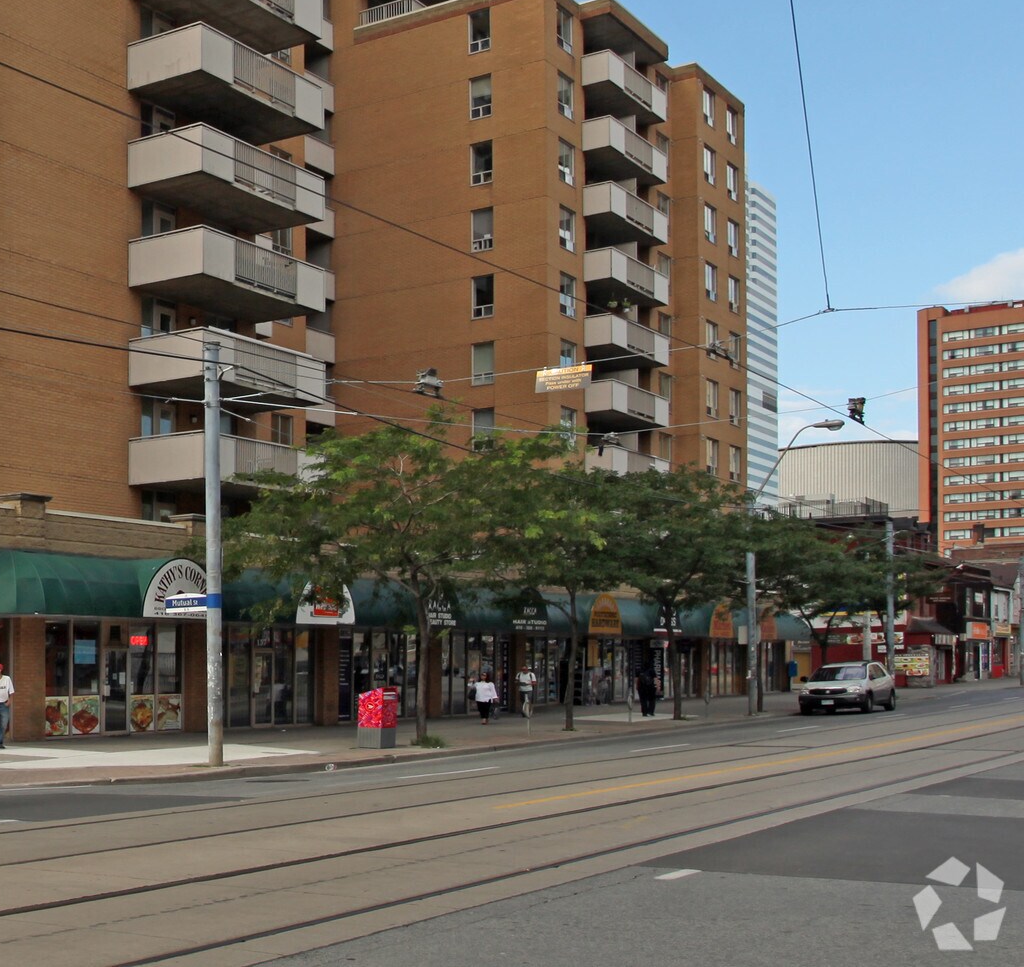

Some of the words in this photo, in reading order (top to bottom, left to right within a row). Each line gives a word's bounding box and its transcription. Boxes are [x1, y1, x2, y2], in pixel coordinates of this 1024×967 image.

[155, 565, 183, 603] KATHY'S
[185, 566, 207, 595] CORN
[172, 599, 193, 607] Mutual
